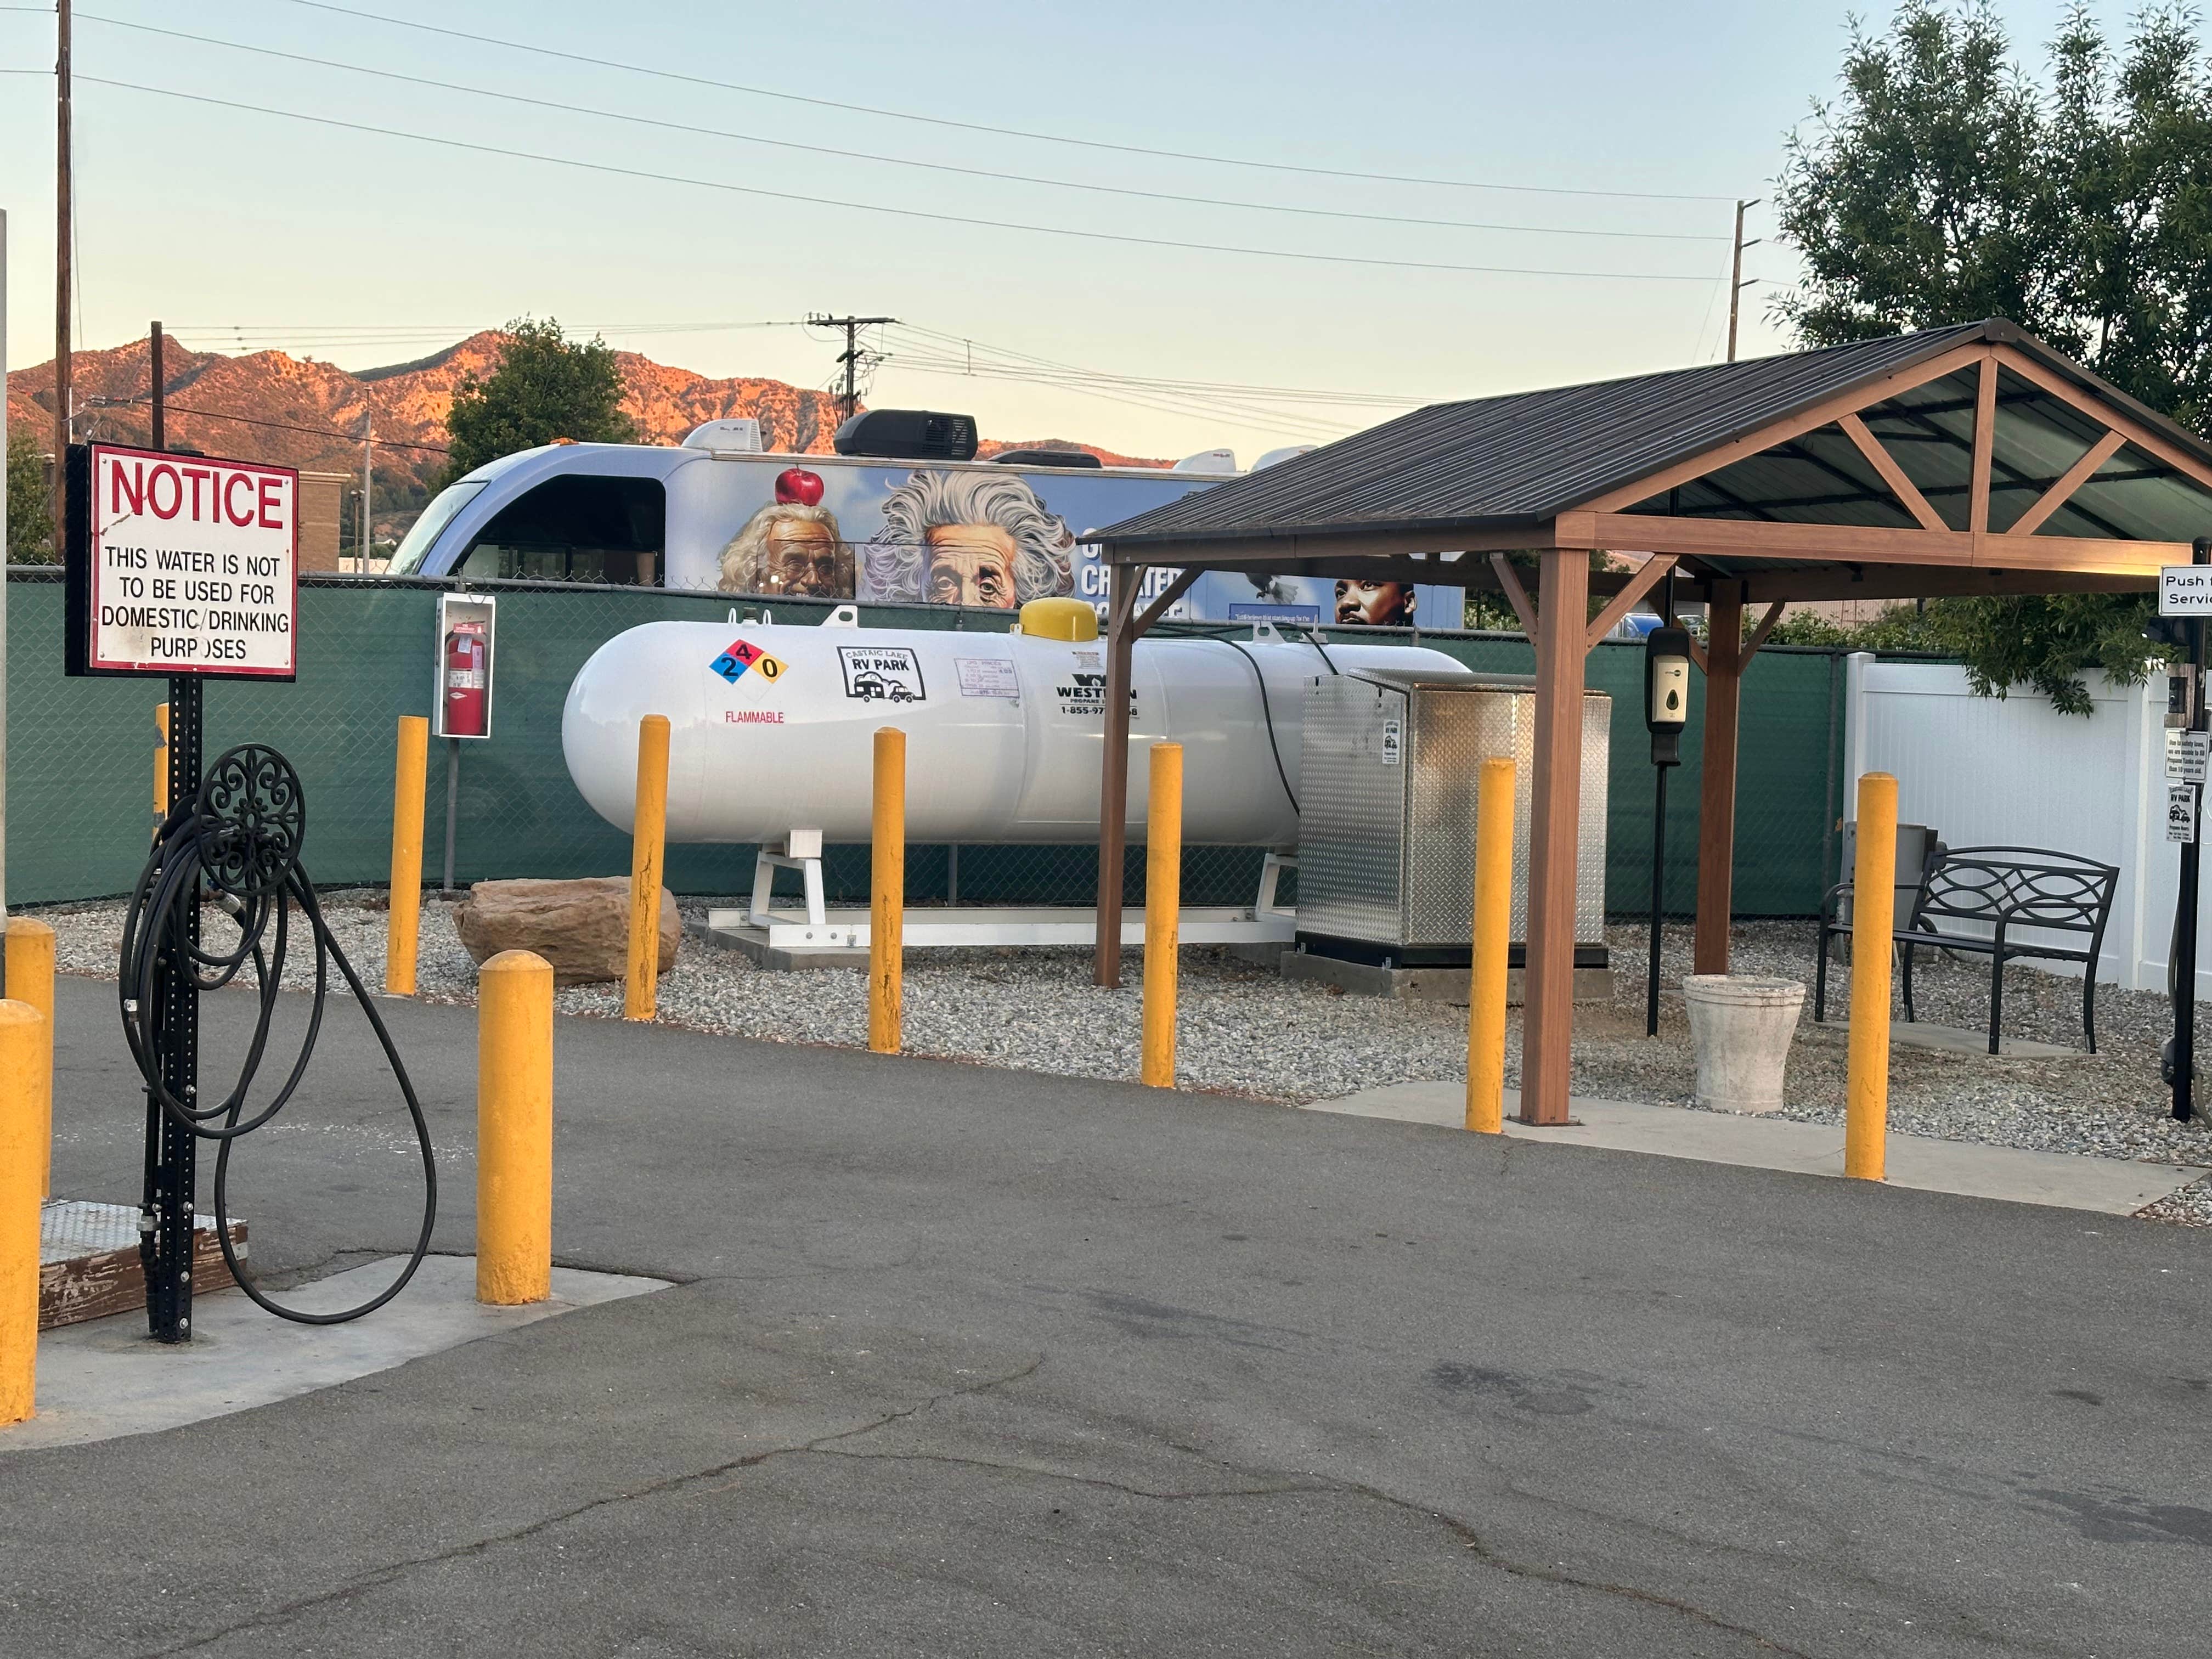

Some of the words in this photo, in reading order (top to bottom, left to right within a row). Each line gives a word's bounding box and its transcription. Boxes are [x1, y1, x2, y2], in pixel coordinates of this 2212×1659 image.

[111, 460, 283, 529] NOTICE
[104, 546, 147, 569] THIS
[156, 549, 215, 573] WATER
[223, 554, 239, 574] IS
[247, 556, 280, 577] NOT
[119, 577, 144, 597] TO
[153, 579, 176, 599] BE
[185, 580, 232, 602] USED
[241, 584, 274, 604] FOR
[1081, 564, 1187, 599] CRTE
[2166, 576, 2204, 586] Push
[101, 606, 289, 633] DOMESTIC/DRINKING
[736, 643, 752, 659] 4
[845, 650, 883, 658] CASTAIC
[885, 651, 908, 659] LAKE
[720, 657, 738, 676] 2
[762, 658, 778, 678] 0
[851, 658, 869, 670] RV
[873, 659, 910, 671] PARK
[1056, 686, 1137, 699] WESTN
[726, 711, 784, 724] FLAMMABLE
